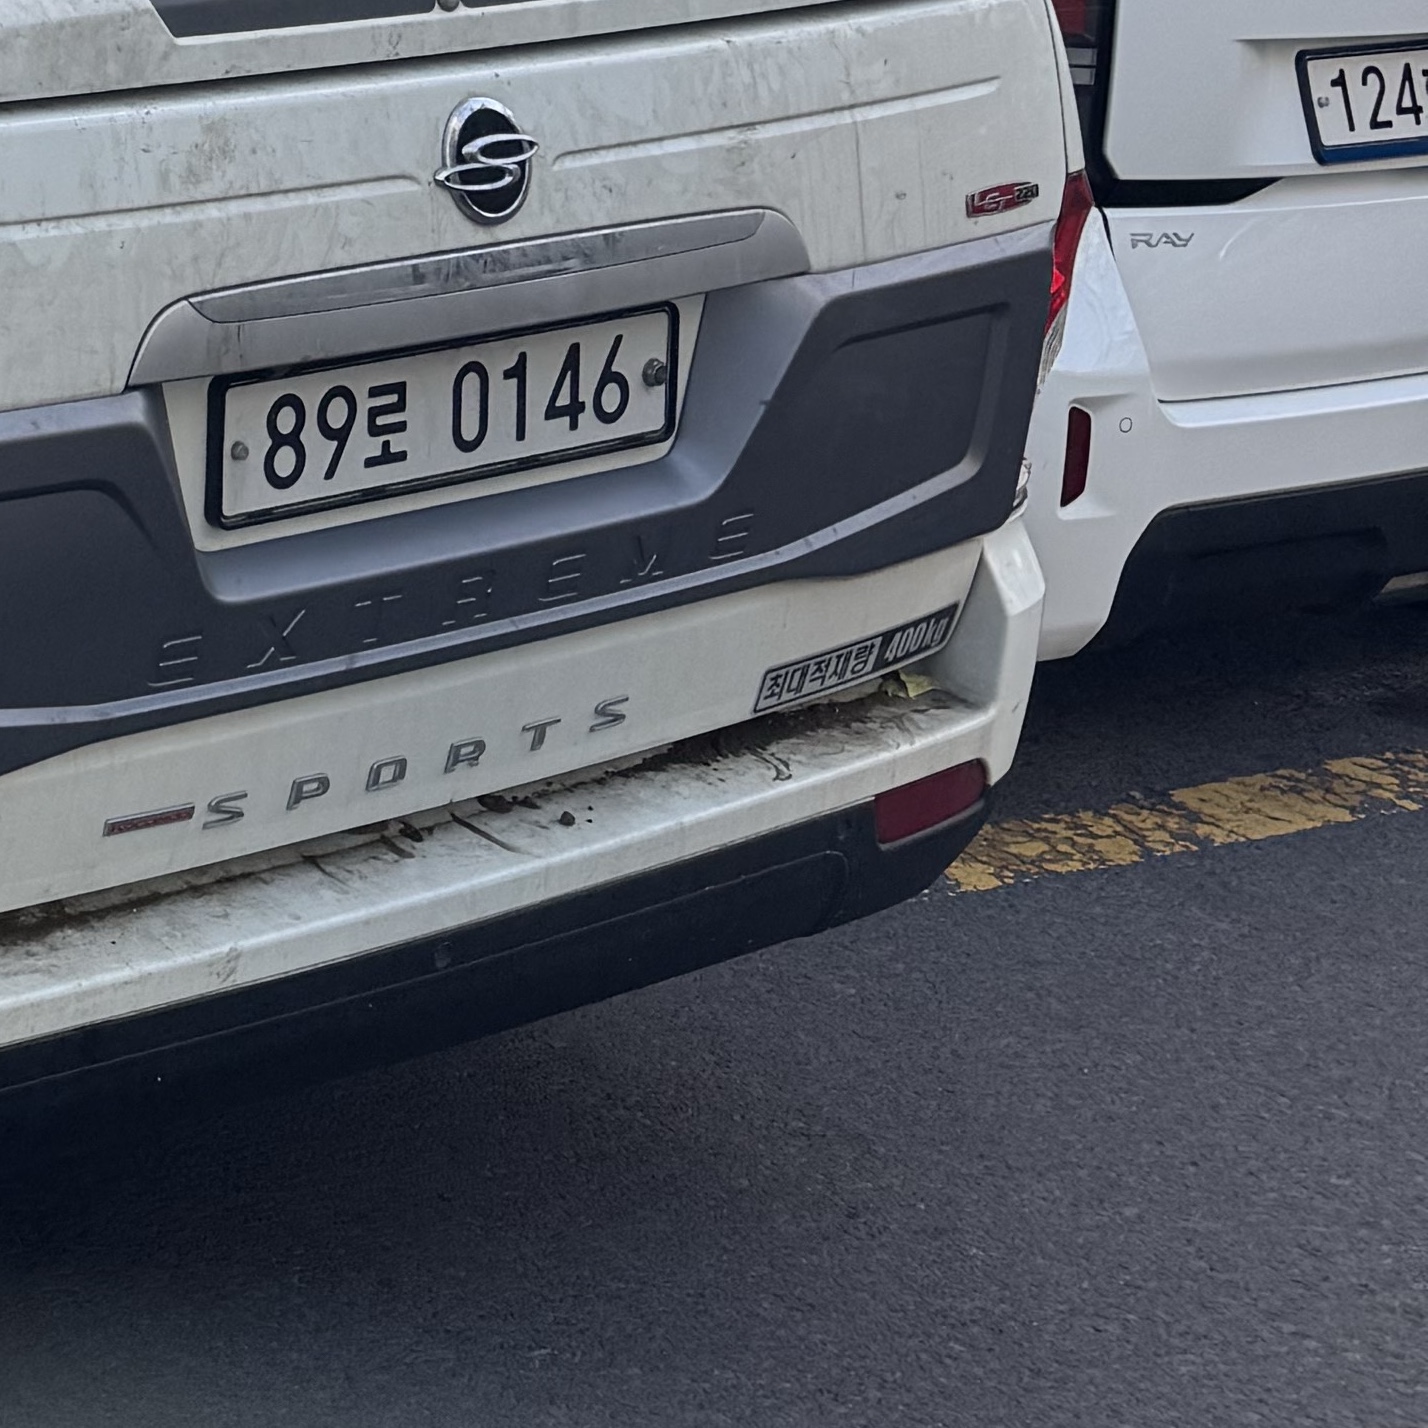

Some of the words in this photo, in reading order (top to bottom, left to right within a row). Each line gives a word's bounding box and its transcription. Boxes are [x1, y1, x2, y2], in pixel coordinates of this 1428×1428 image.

[1330, 62, 1428, 133] 124
[1130, 231, 1195, 251] RAY
[263, 380, 409, 491] 89로
[452, 333, 631, 453] 0146
[147, 512, 756, 687] EXTREME
[763, 640, 877, 702] 최대적재량
[883, 616, 950, 665] 400kg
[201, 694, 631, 833] SPORTS
